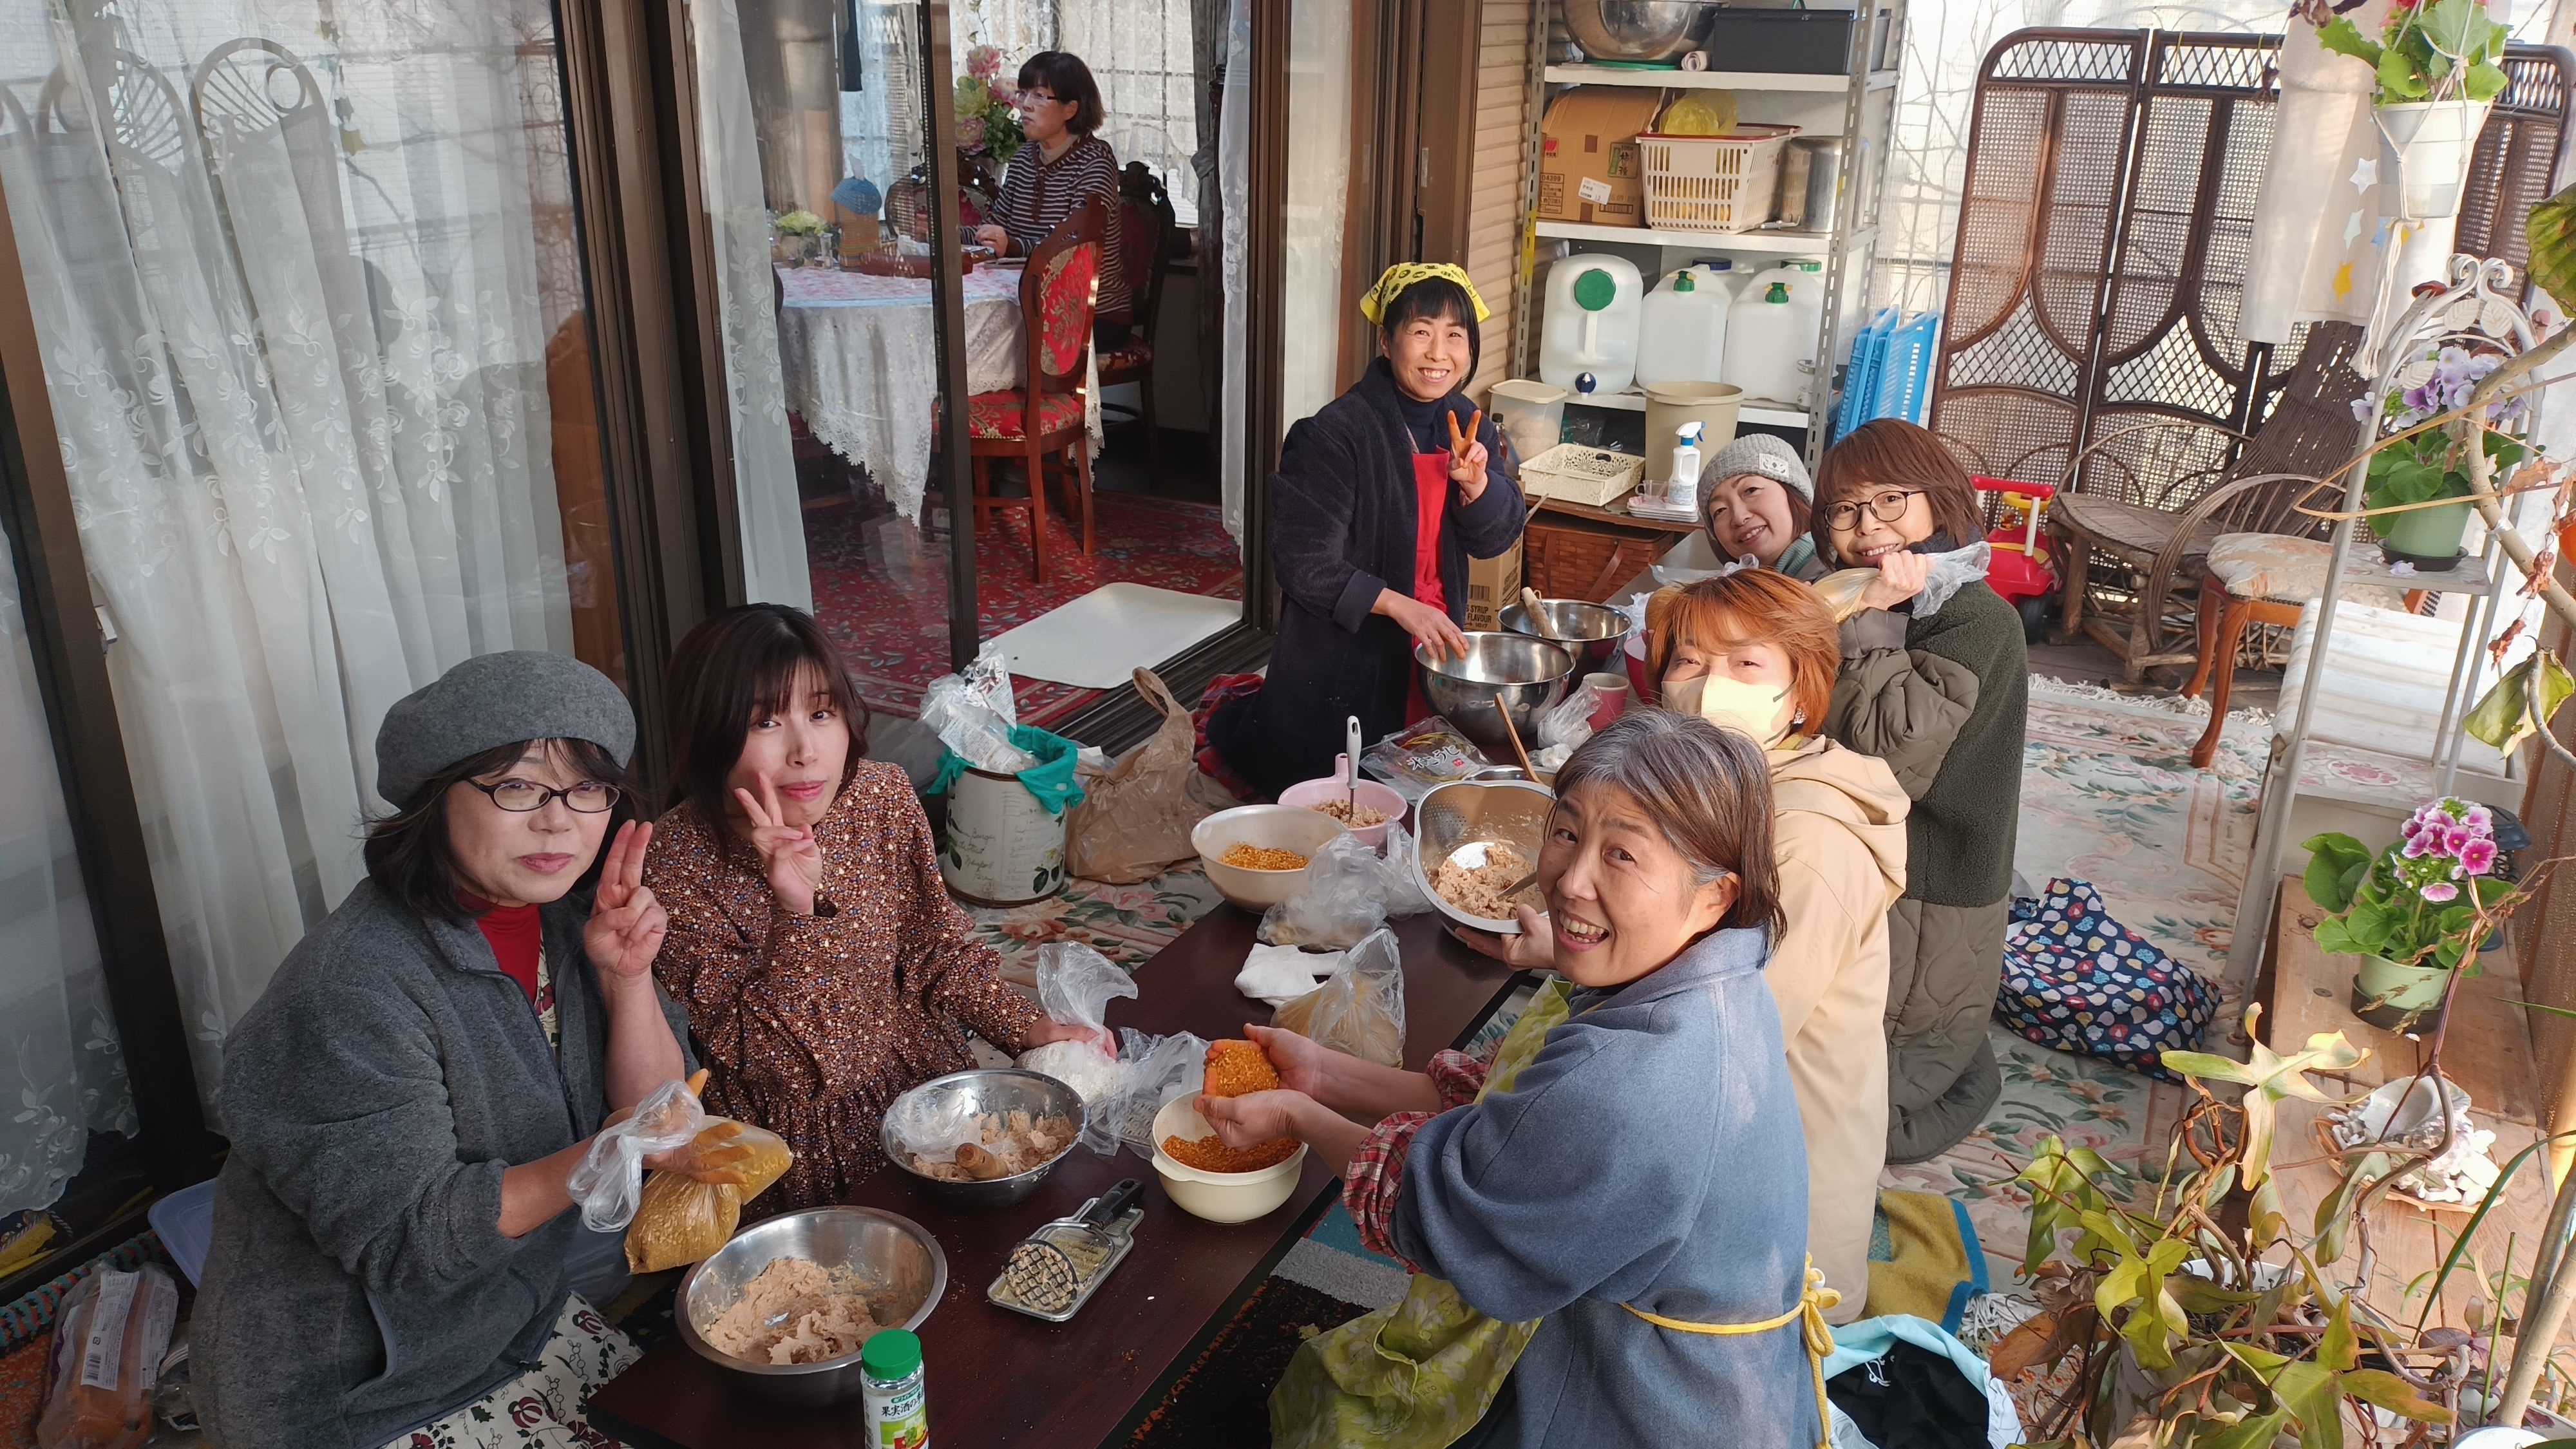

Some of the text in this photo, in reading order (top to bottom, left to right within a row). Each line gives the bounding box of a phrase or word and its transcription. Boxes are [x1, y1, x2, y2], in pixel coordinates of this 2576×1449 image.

[1470, 605, 1489, 614] SYRUP
[1467, 612, 1492, 623] FLAVOUR
[1406, 744, 1461, 770] 米こうじ
